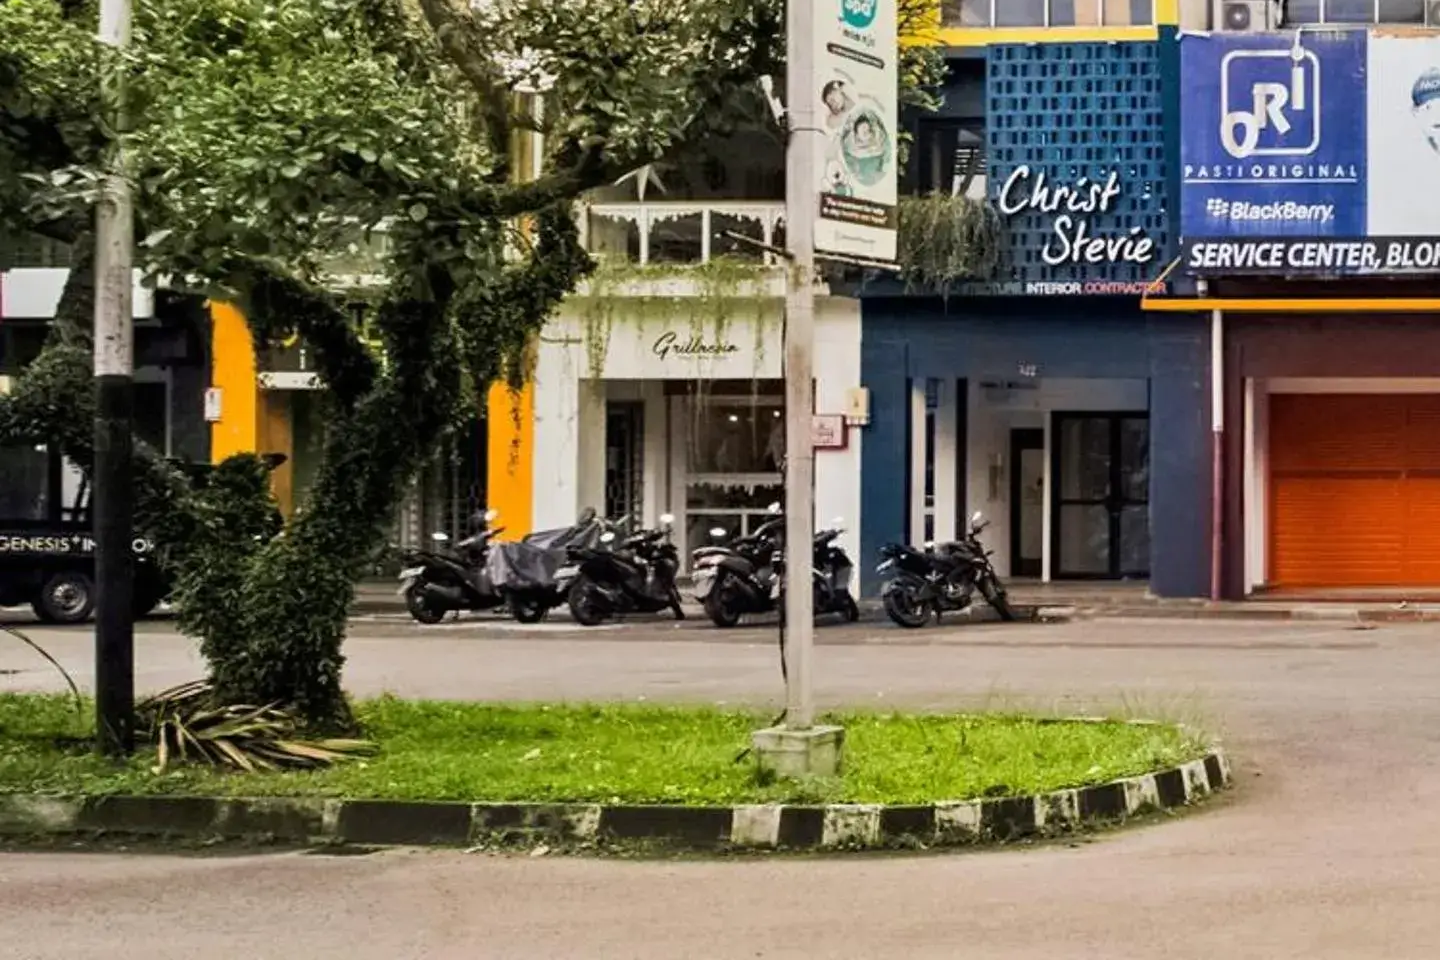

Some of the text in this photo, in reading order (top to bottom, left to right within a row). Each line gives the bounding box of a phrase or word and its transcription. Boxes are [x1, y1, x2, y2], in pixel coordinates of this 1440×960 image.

[1184, 164, 1357, 177] PASTI ORIGINAL
[1000, 165, 1120, 214] Christ
[1042, 214, 1153, 265] Stevie
[1189, 243, 1283, 268] SERVICE
[1287, 243, 1382, 271] CENTER,
[1027, 282, 1081, 295] INTERIOR
